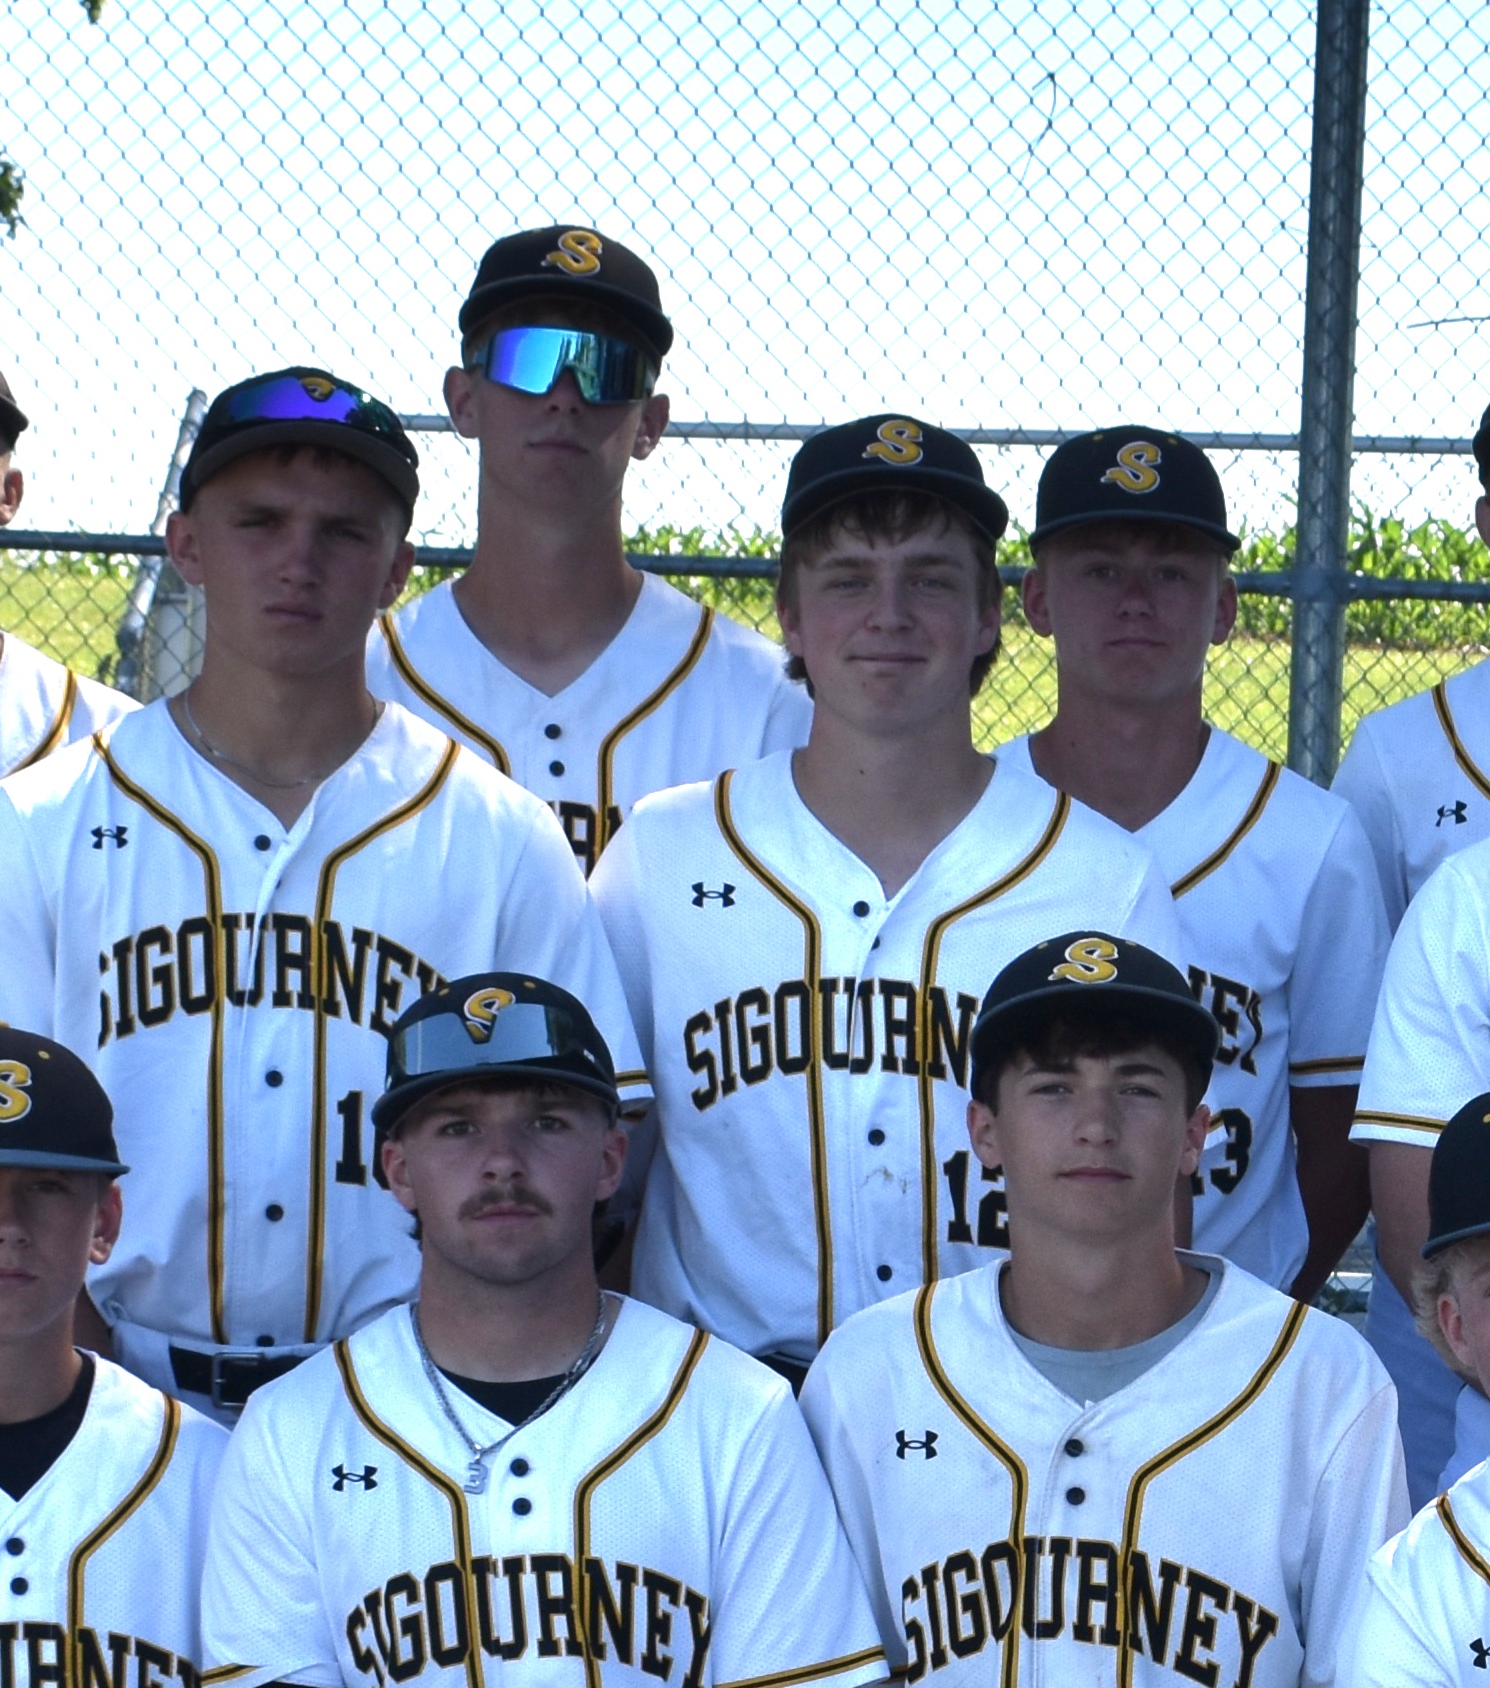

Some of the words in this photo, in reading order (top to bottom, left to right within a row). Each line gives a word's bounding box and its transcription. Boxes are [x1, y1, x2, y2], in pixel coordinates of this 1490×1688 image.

[542, 229, 603, 276] S
[862, 418, 925, 467] S
[1101, 440, 1162, 493] S
[1048, 936, 1120, 984] S
[335, 1090, 392, 1191] 1
[1191, 1107, 1253, 1196] 3
